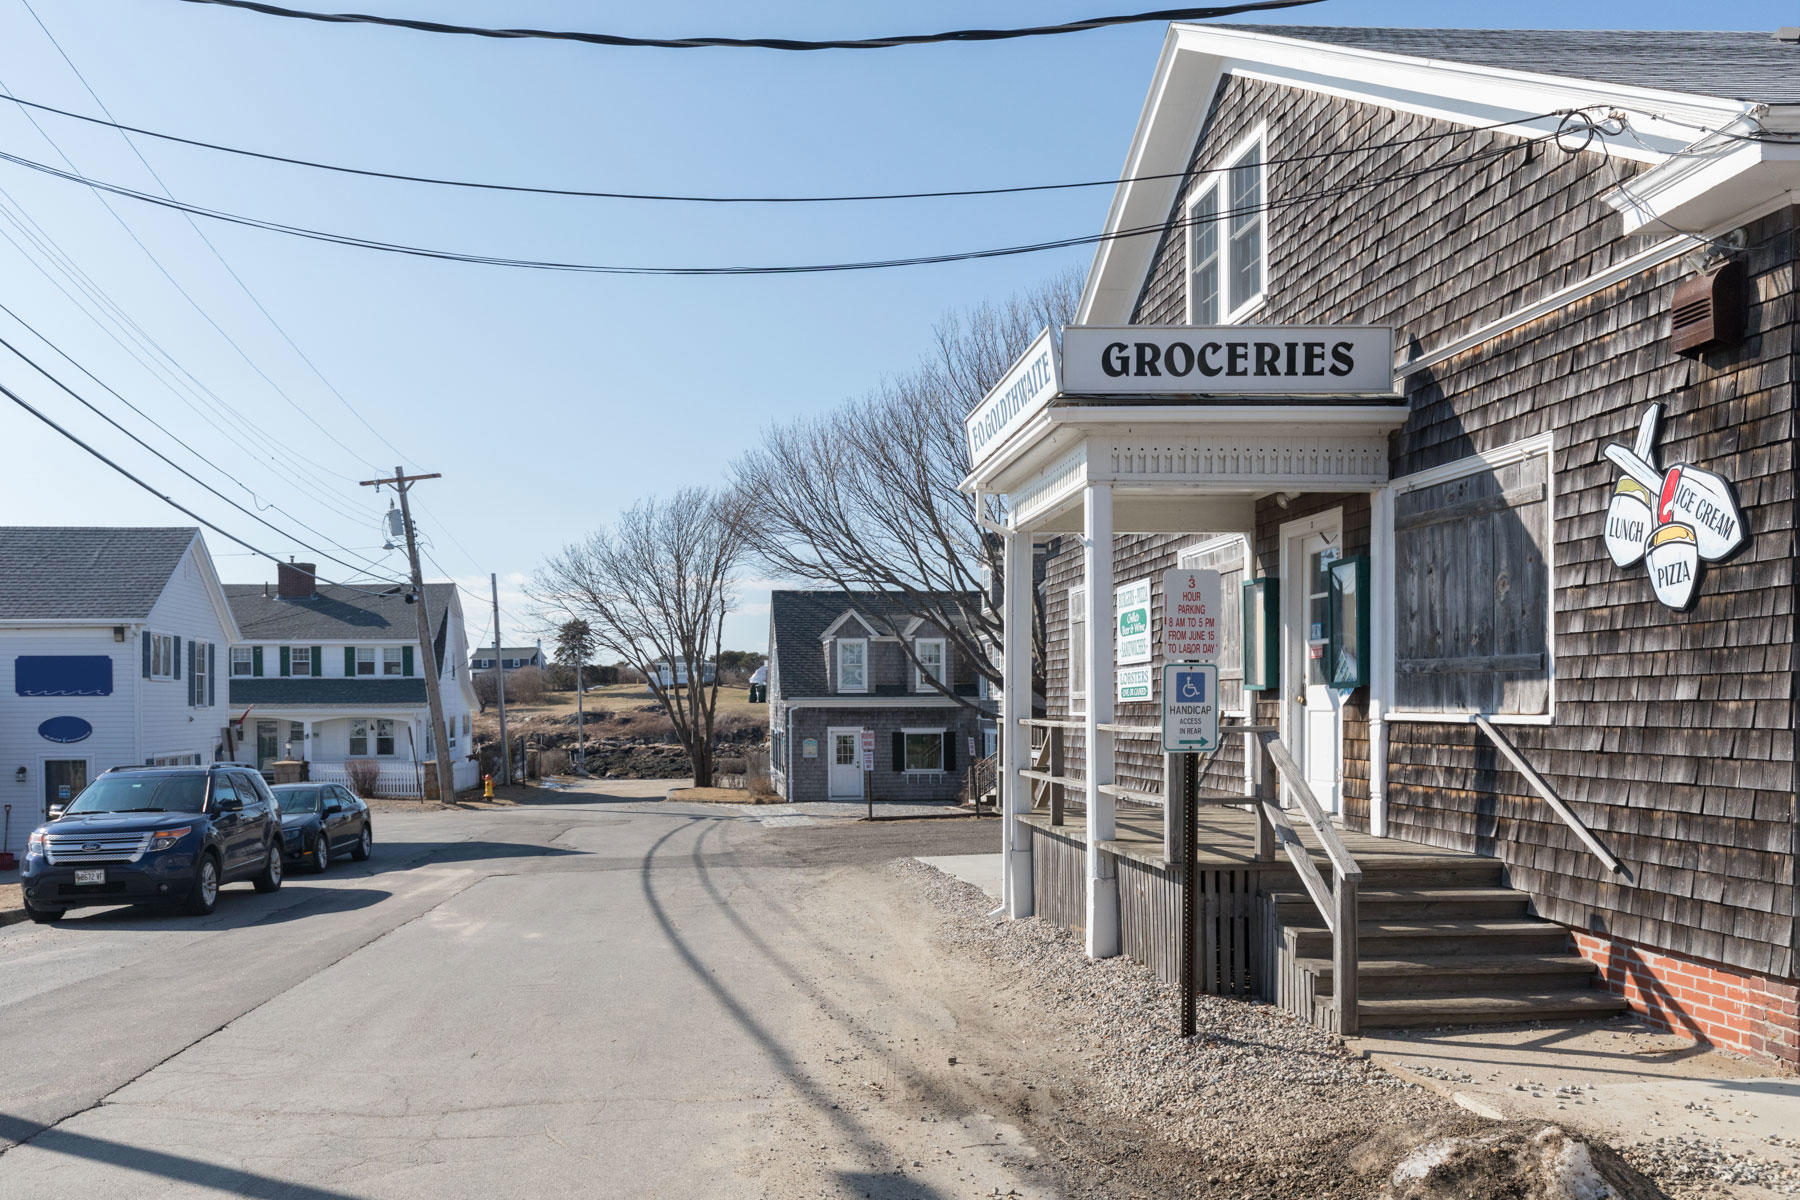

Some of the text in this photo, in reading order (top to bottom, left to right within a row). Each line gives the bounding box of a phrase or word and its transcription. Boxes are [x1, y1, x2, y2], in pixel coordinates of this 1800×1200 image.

[1101, 341, 1355, 378] GROCERIES
[1675, 484, 1736, 541] ICE CREAM
[1609, 516, 1645, 543] LUNCH
[1657, 560, 1691, 589] PIZZA
[1188, 578, 1196, 589] 3
[1182, 591, 1201, 602] HOUR
[1177, 604, 1206, 615] PARKING
[1168, 616, 1215, 628] 8 AM TO 5 PM
[1168, 630, 1215, 641] FROM JUNE 15
[1168, 643, 1215, 654] TO LABOR DAY
[1119, 671, 1149, 685] LOBSTERS
[1169, 705, 1212, 715] HANDICAP
[1179, 717, 1202, 725] ACCESS
[1179, 727, 1202, 735] IN REAR
